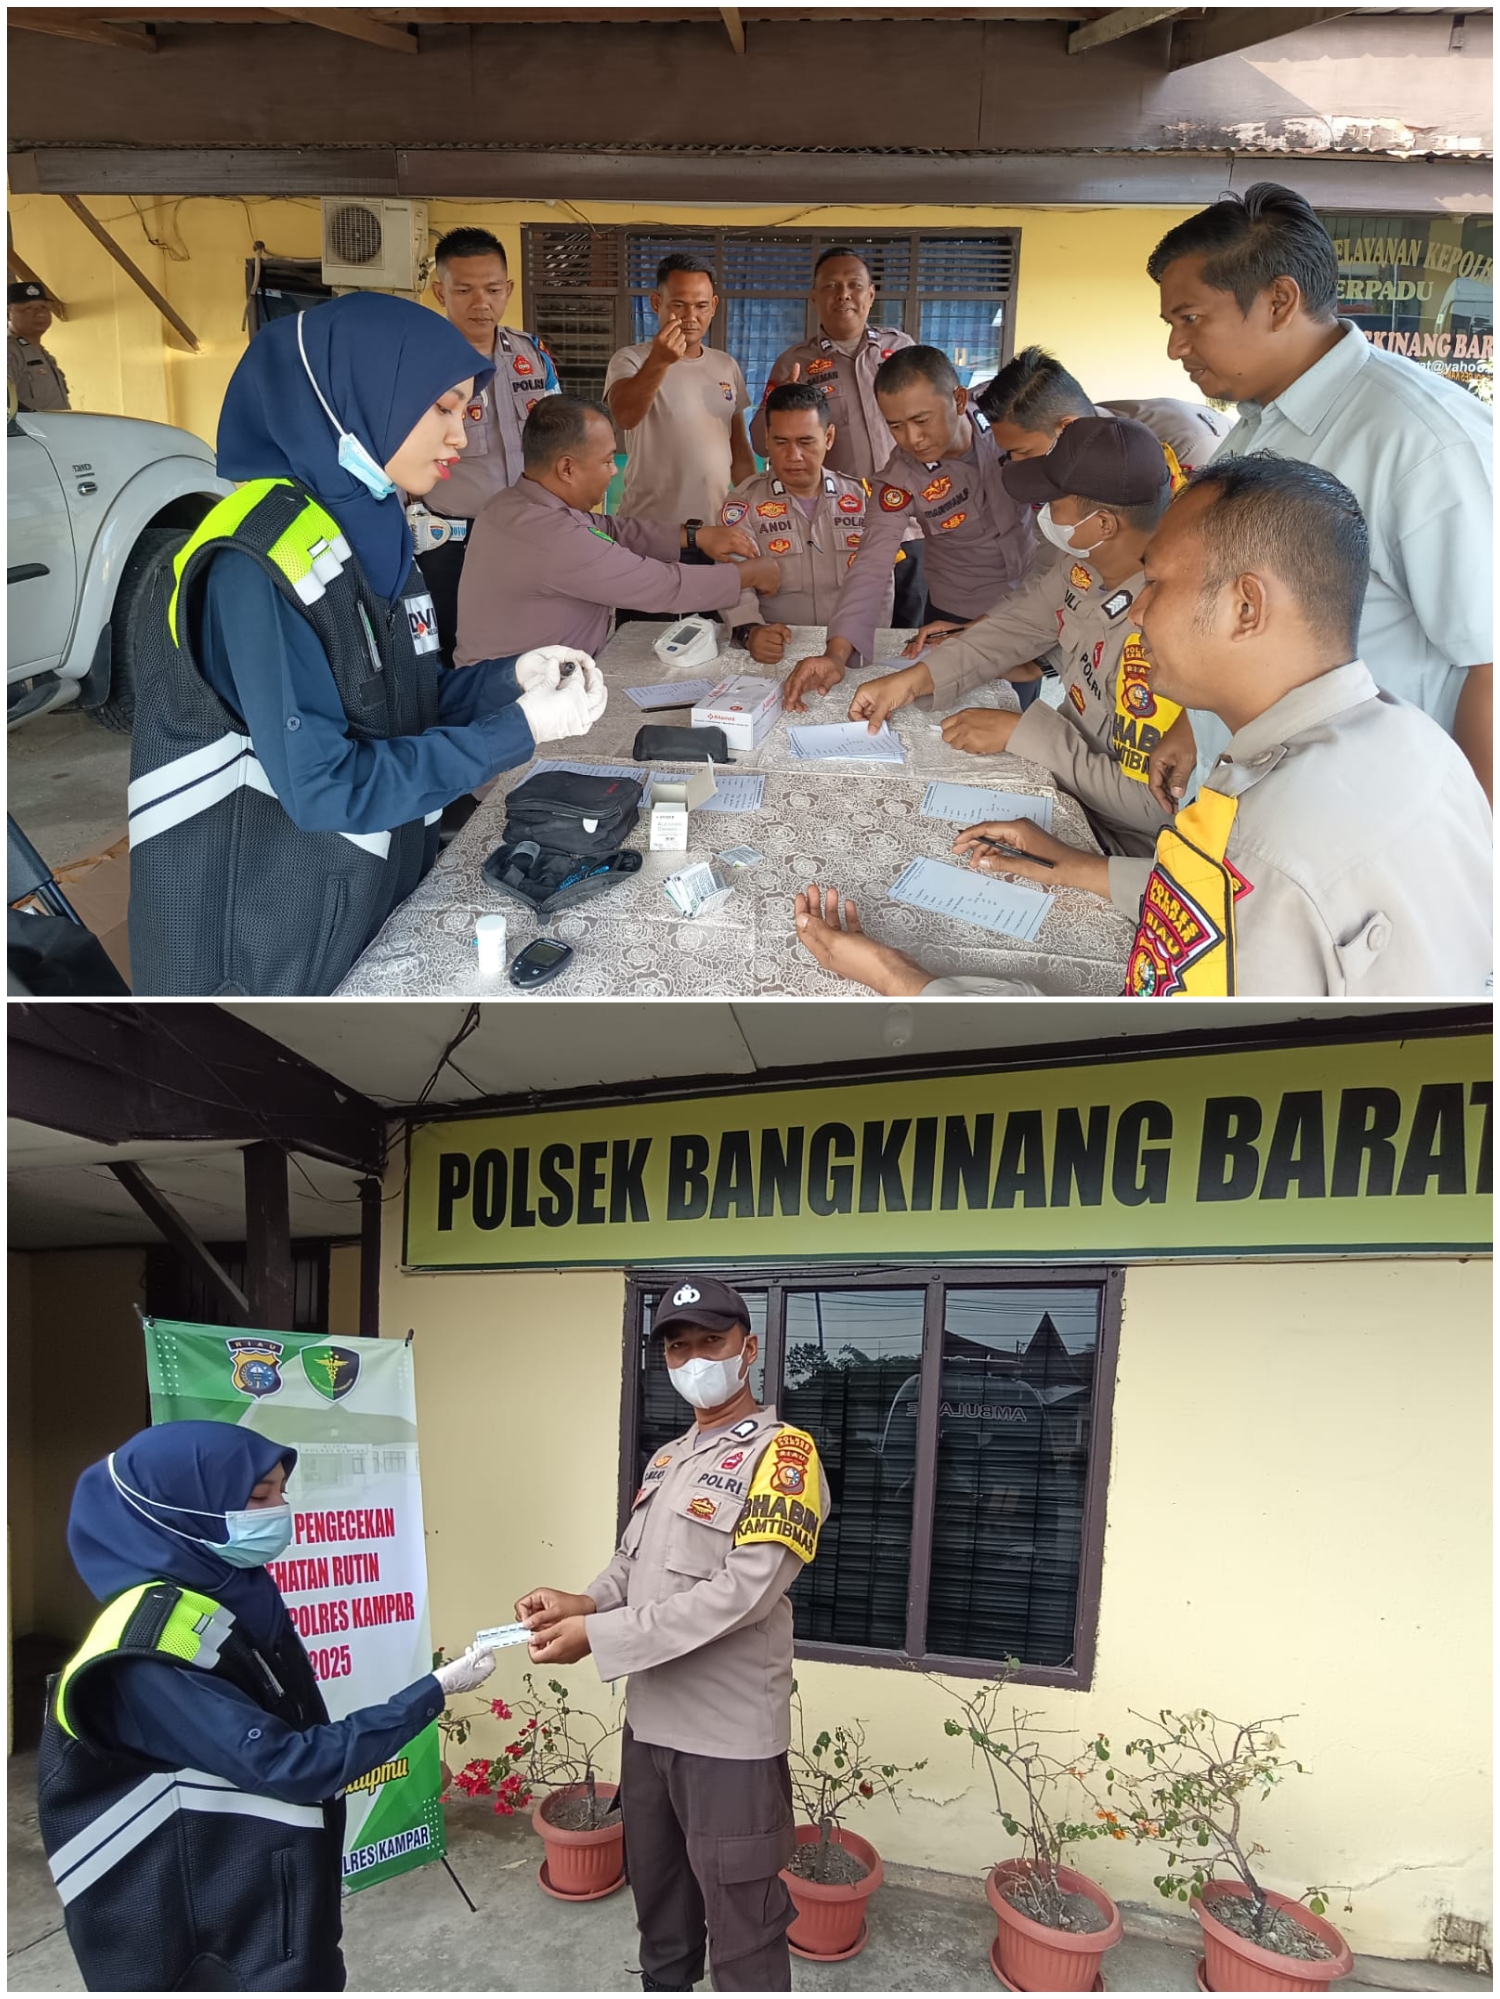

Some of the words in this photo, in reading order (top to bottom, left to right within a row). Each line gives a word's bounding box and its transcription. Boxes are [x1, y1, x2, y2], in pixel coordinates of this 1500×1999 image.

[1332, 236, 1422, 267] ELAYANAN
[1336, 279, 1434, 301] ERPADU
[1453, 334, 1493, 359] BAR
[512, 378, 544, 393] POLRI
[759, 519, 792, 535] ANDI
[833, 516, 864, 528] POLR
[408, 607, 439, 634] DVI
[1080, 652, 1102, 701] POLRI
[1151, 877, 1200, 937] POLRES
[1145, 911, 1180, 955] RIAU
[437, 1137, 653, 1232] POLSEK
[666, 1099, 1173, 1221] BANGKINANG
[234, 1341, 277, 1351] RIAU
[697, 1472, 743, 1495] POLRI
[293, 1507, 396, 1545] PENGECEKAN
[331, 1552, 380, 1587] RUTIN
[351, 1591, 415, 1630] KAMPAR
[308, 1644, 352, 1682] 2025
[342, 1845, 376, 1875] LRES
[378, 1825, 430, 1861] KAMPAR
